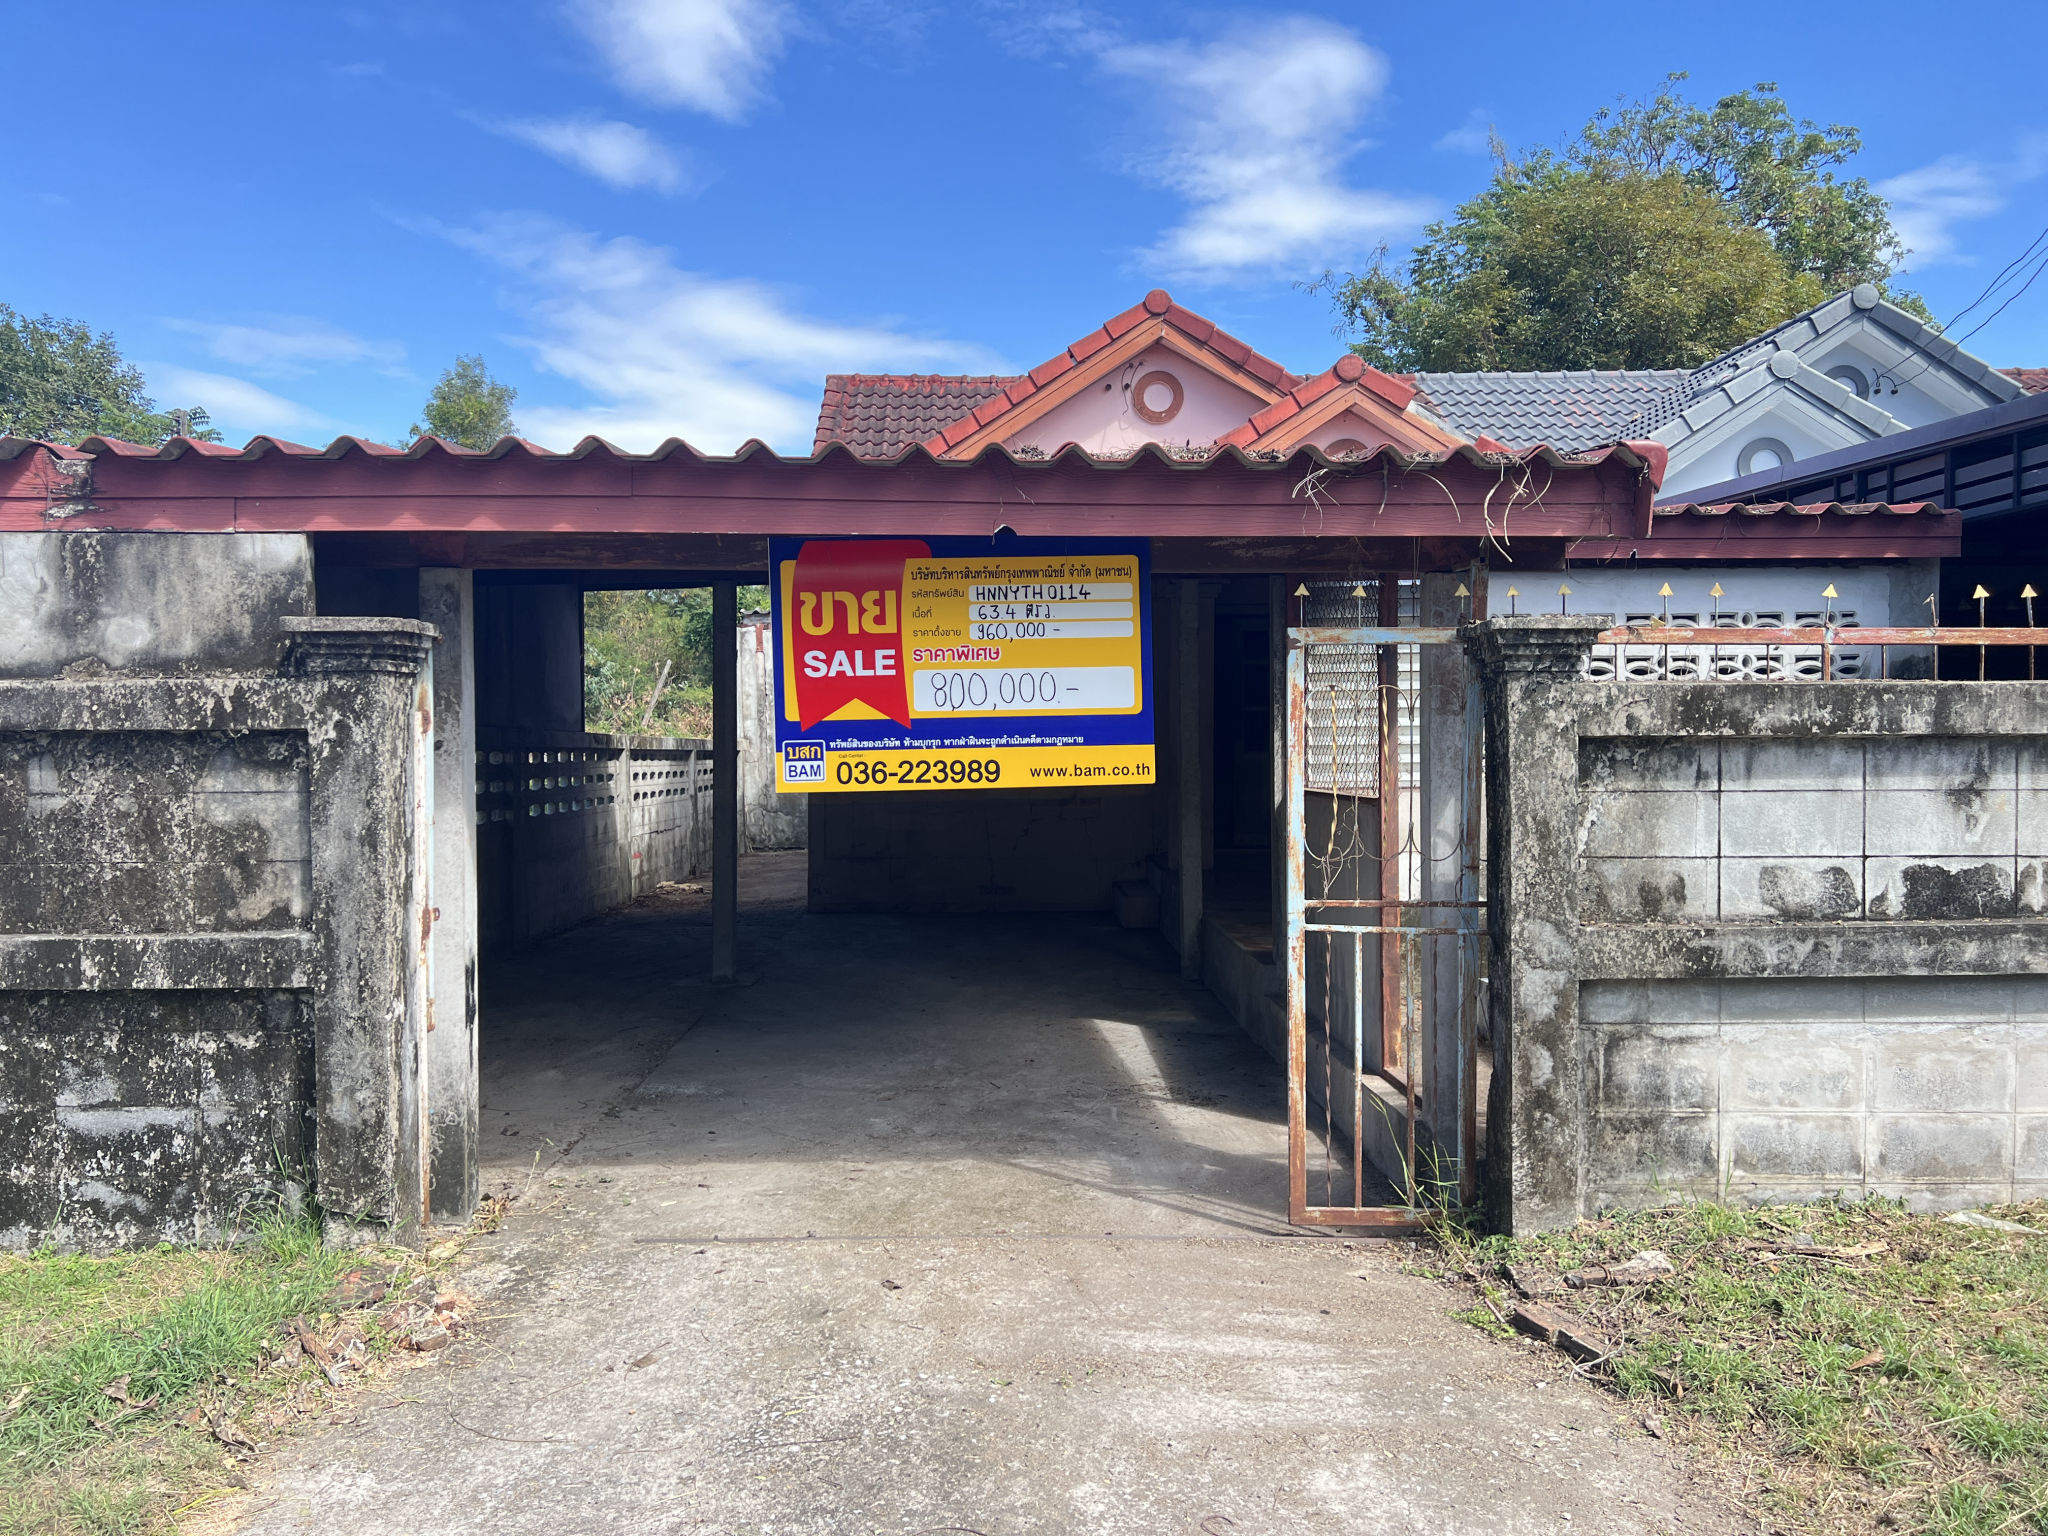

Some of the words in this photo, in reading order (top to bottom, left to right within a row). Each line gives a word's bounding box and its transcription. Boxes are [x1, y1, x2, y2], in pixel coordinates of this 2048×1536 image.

[911, 564, 1065, 583] บริษัทบริหารสินทรัพย์กรุงเทพพาณิชย์
[1069, 566, 1092, 578] จำกัด
[1095, 566, 1132, 579] (มหาชน)
[911, 587, 965, 599] รหัสทรัพย์สิน
[800, 590, 898, 636] ขาย
[912, 606, 933, 619] เนื้อที่
[912, 625, 962, 638] ราคาตั้งขาย
[912, 645, 1001, 663] ราคาพิเศษ
[803, 649, 897, 678] SALE
[829, 738, 901, 749] ทรัพย์สินของบริษัท
[903, 736, 941, 750] ห้ามบุกรุก
[787, 746, 821, 760] บสก
[788, 764, 822, 778] BAM
[836, 759, 1001, 785] 036-223989
[1030, 763, 1151, 778] www.bam.co.th
